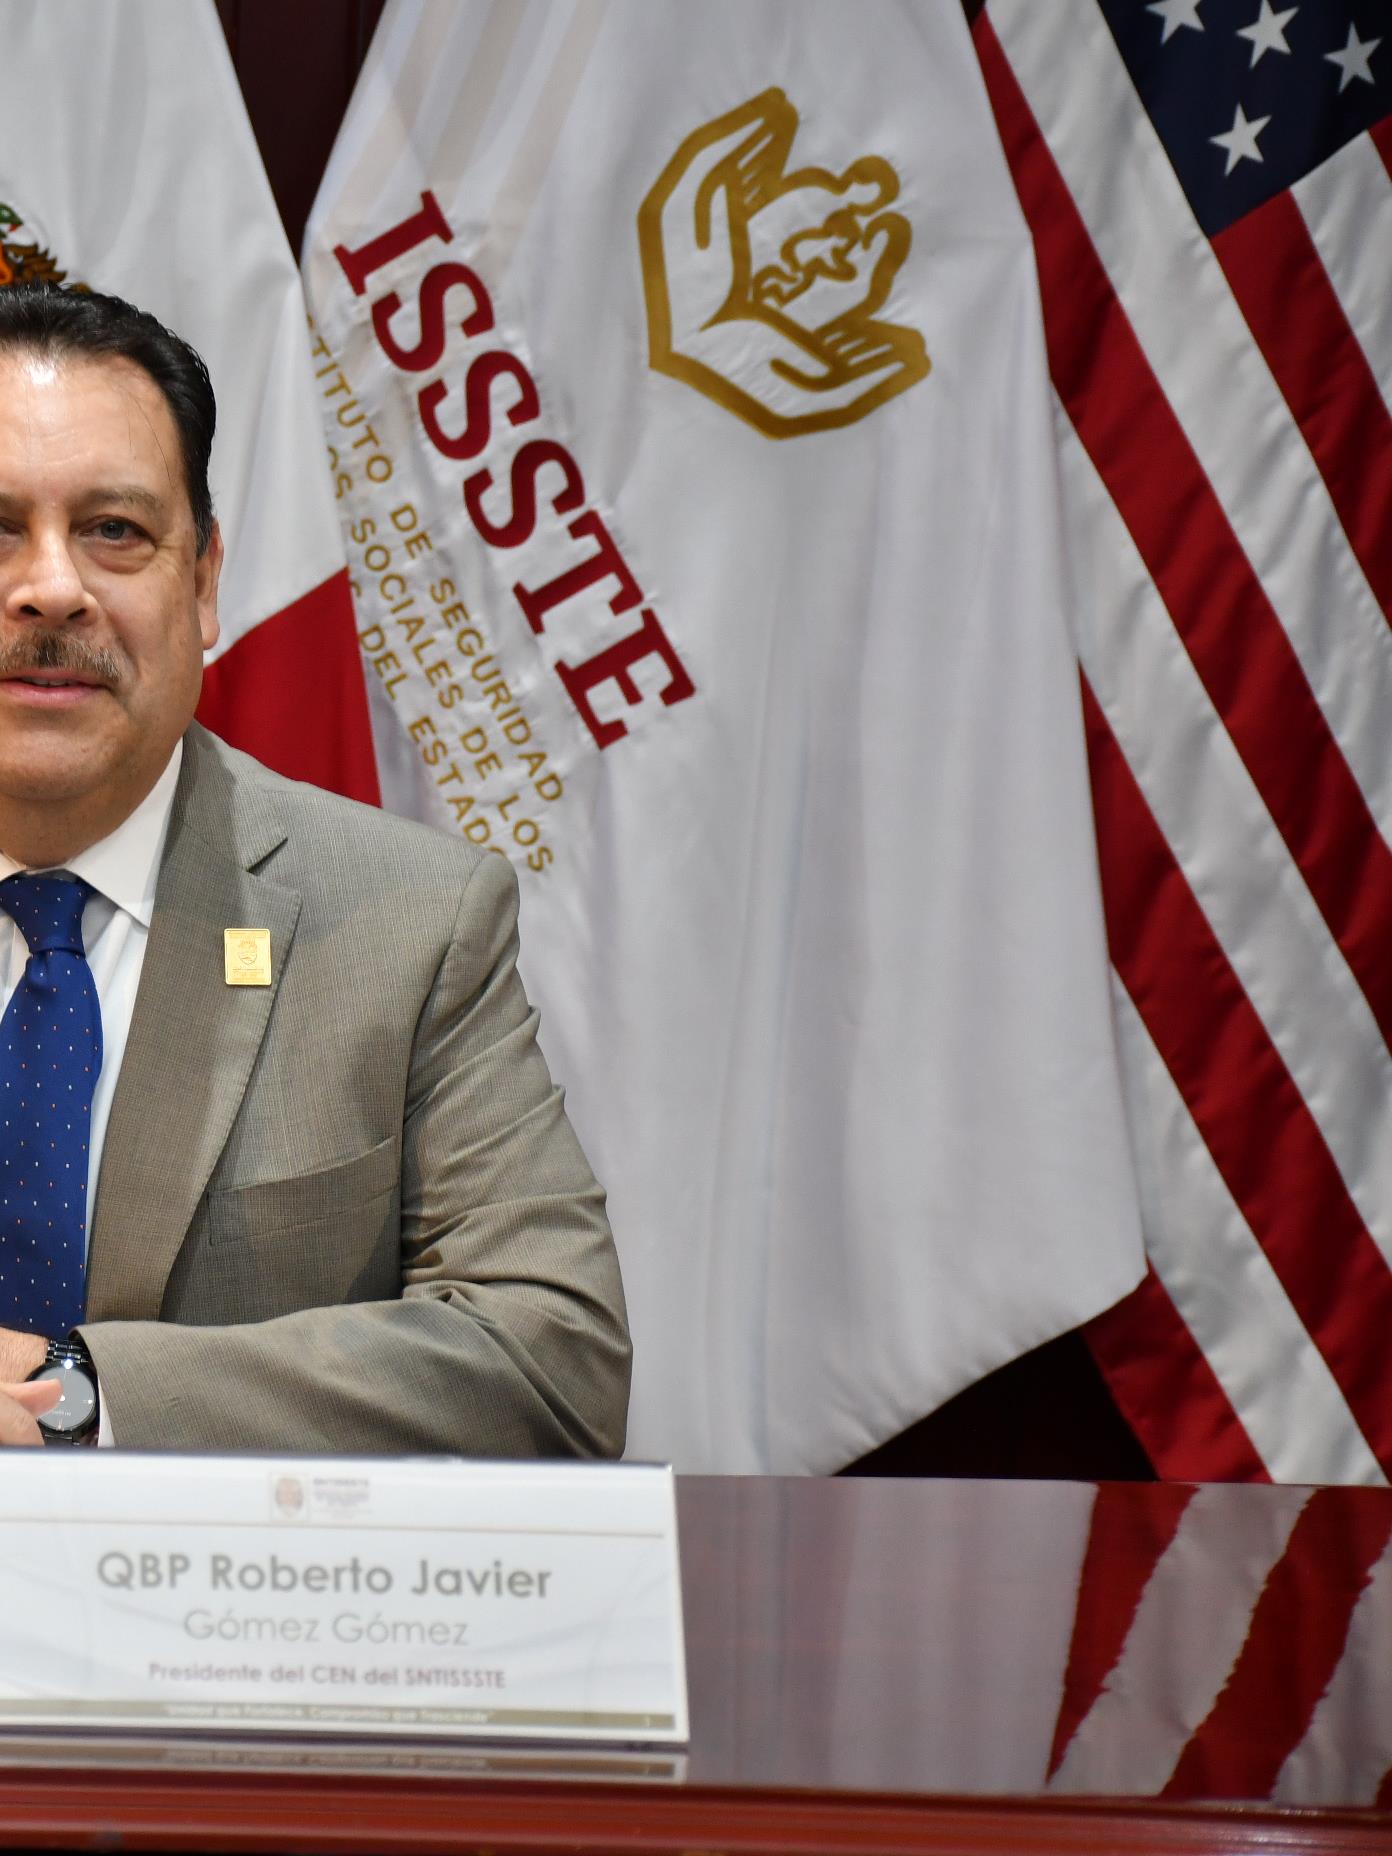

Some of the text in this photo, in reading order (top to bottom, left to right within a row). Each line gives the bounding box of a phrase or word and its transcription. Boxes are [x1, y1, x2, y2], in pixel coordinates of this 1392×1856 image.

[307, 314, 564, 803] TITUTO DE SEGURIDAD
[333, 190, 696, 751] ISSSTE
[351, 518, 465, 710] SOCIALES
[461, 726, 504, 781] DE
[497, 795, 554, 872] LOS
[358, 624, 507, 857] DEL ESTAD
[97, 1551, 553, 1598] QBP Roberto Javier
[148, 1663, 506, 1689] Presidente del CEN del SNTISSSTE
[183, 1608, 469, 1647] Gómez Gómez
